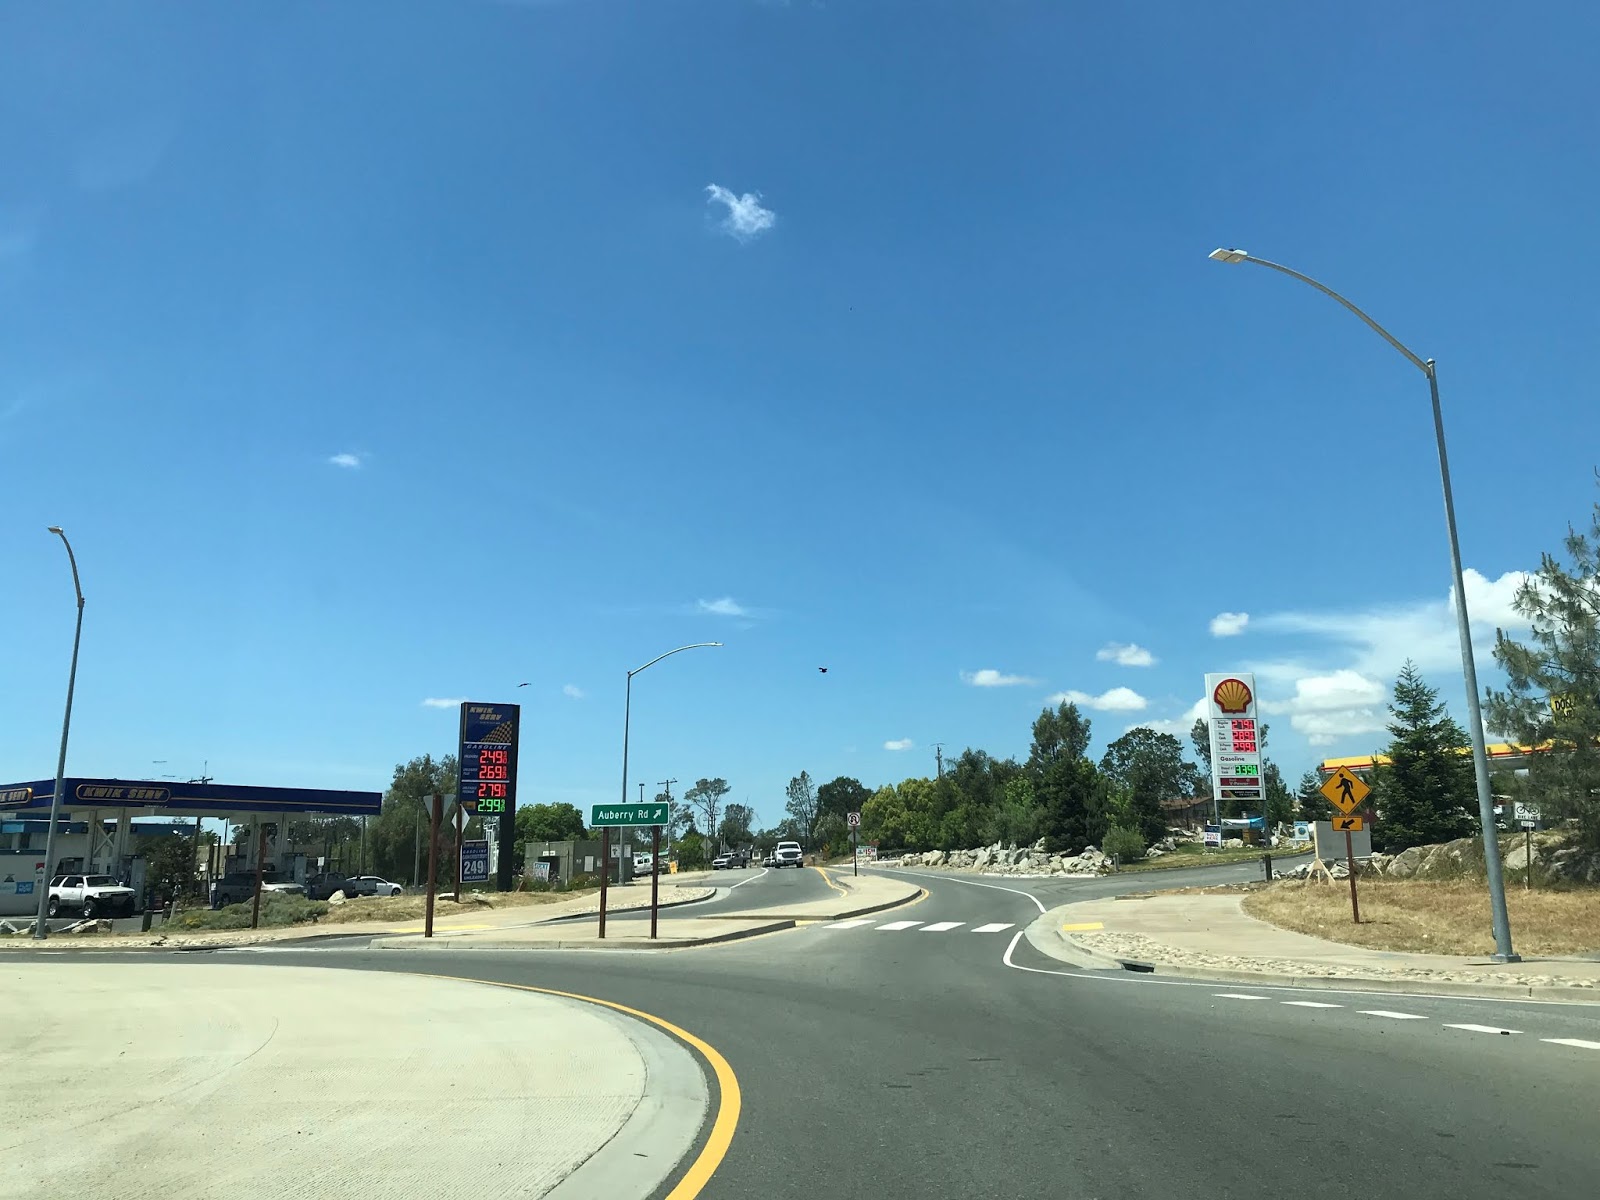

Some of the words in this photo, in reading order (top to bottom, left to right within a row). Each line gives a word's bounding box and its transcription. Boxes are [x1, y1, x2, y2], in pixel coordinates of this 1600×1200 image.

[83, 787, 124, 798] KWIK
[127, 789, 164, 799] SERV
[598, 810, 634, 821] Auberry
[638, 810, 649, 819] Rd
[464, 861, 484, 874] 249
